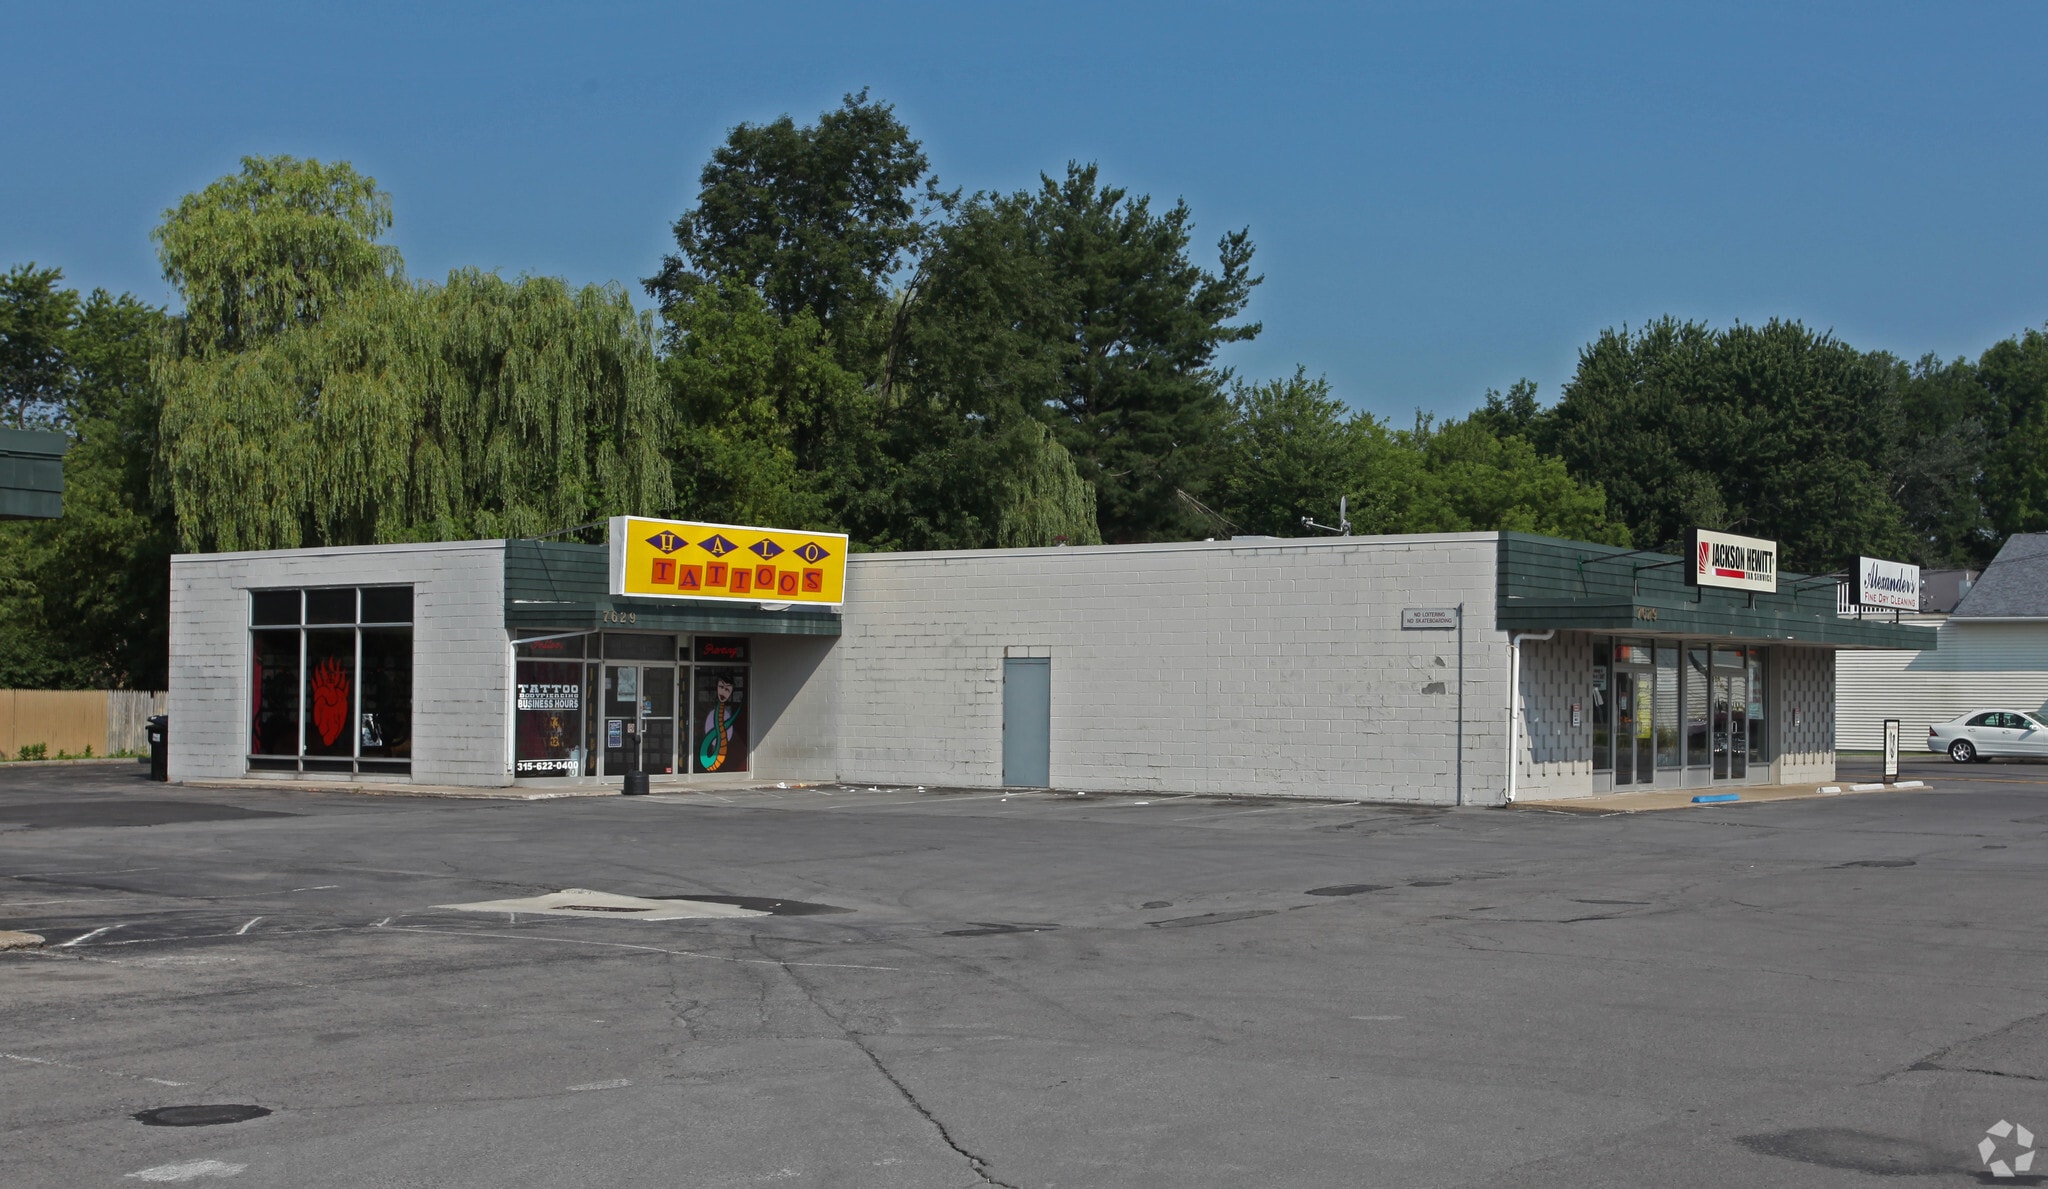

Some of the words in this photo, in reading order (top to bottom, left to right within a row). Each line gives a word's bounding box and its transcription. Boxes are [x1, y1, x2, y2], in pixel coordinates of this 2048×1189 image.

[659, 533, 819, 562] HALO
[1712, 543, 1745, 570] JACKSON
[1746, 549, 1773, 573] HEWITT
[656, 562, 820, 592] TATTOOS
[1745, 572, 1753, 580] TAX
[1754, 573, 1772, 582] SERVICE
[1864, 561, 1915, 594] Alexander's
[1865, 592, 1877, 602] FINE
[1879, 594, 1889, 603] DRY
[1890, 595, 1916, 607] CLEANING
[603, 611, 636, 623] 7629
[517, 684, 579, 693] TATTOO
[517, 698, 554, 709] BUSINESS
[554, 699, 579, 708] HOURS
[517, 761, 579, 771] 315-622-0400
